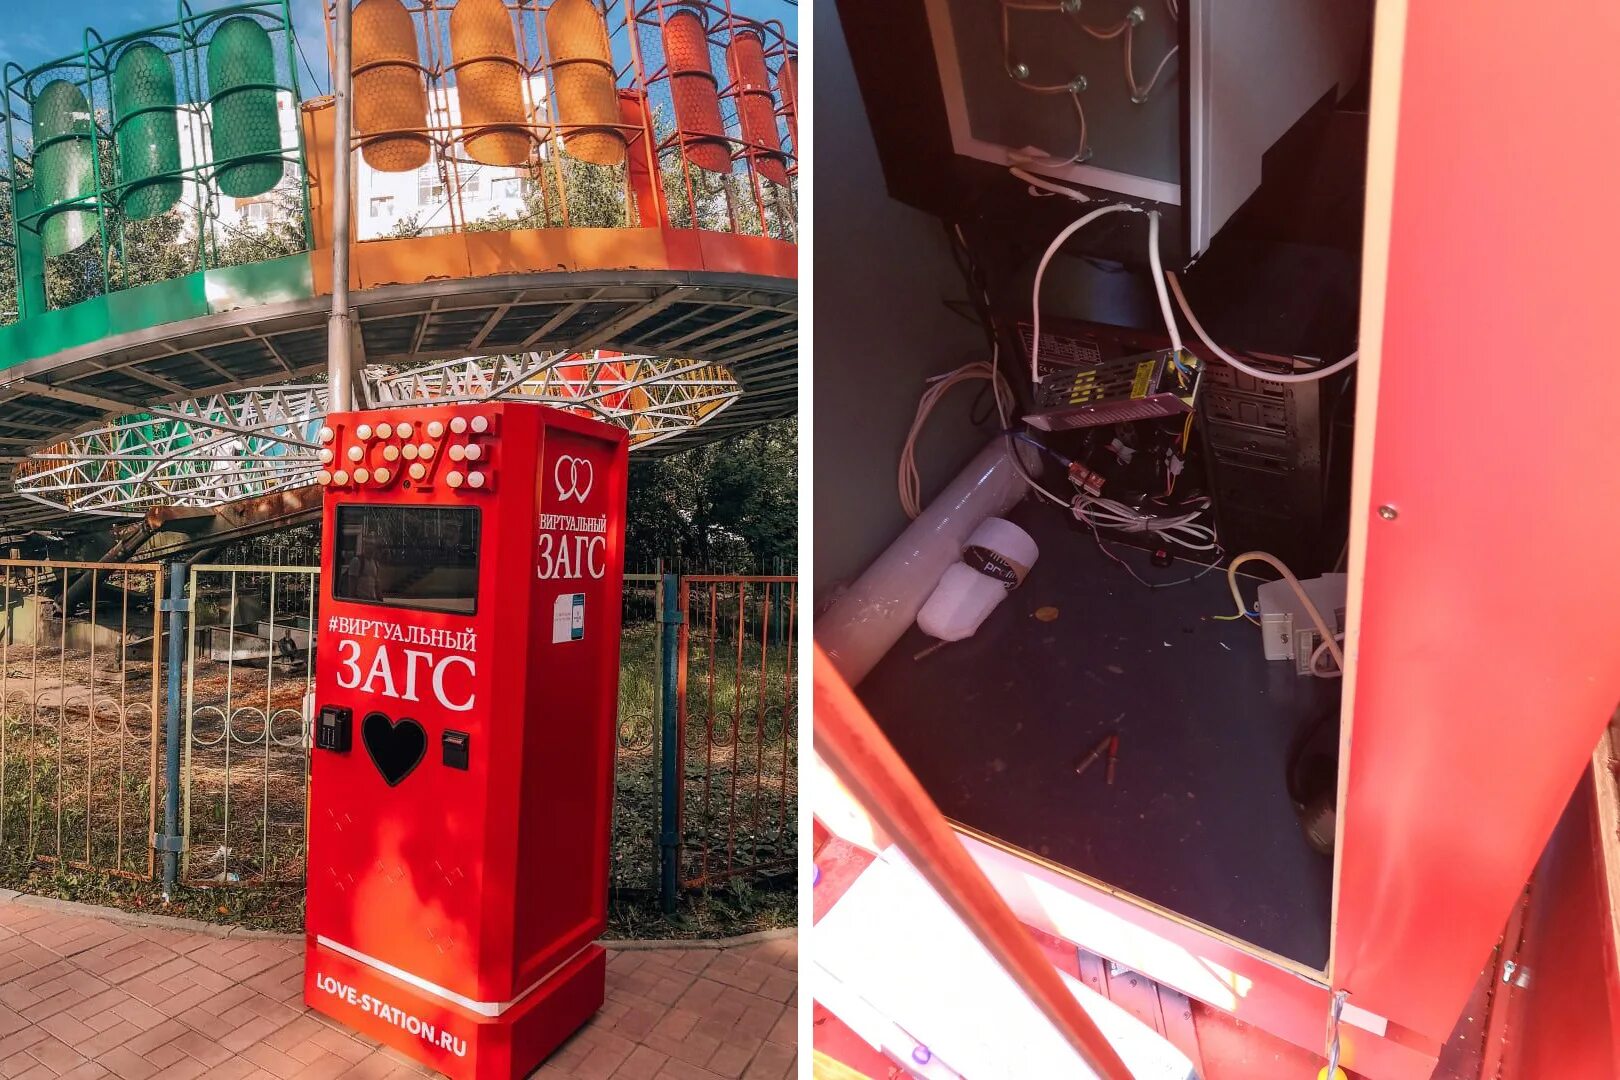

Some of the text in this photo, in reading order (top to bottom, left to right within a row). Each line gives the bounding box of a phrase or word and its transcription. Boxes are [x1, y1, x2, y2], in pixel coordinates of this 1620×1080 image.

[317, 414, 499, 491] LOVE
[539, 513, 606, 533] ВИРТУАЛЬНЫЙ
[537, 533, 606, 580] ЗАГС
[329, 615, 477, 652] #ВИРТУАЛЬНЫЙ
[336, 639, 477, 711] ЗАГС
[316, 972, 467, 1057] LOVE-STATION.RU
